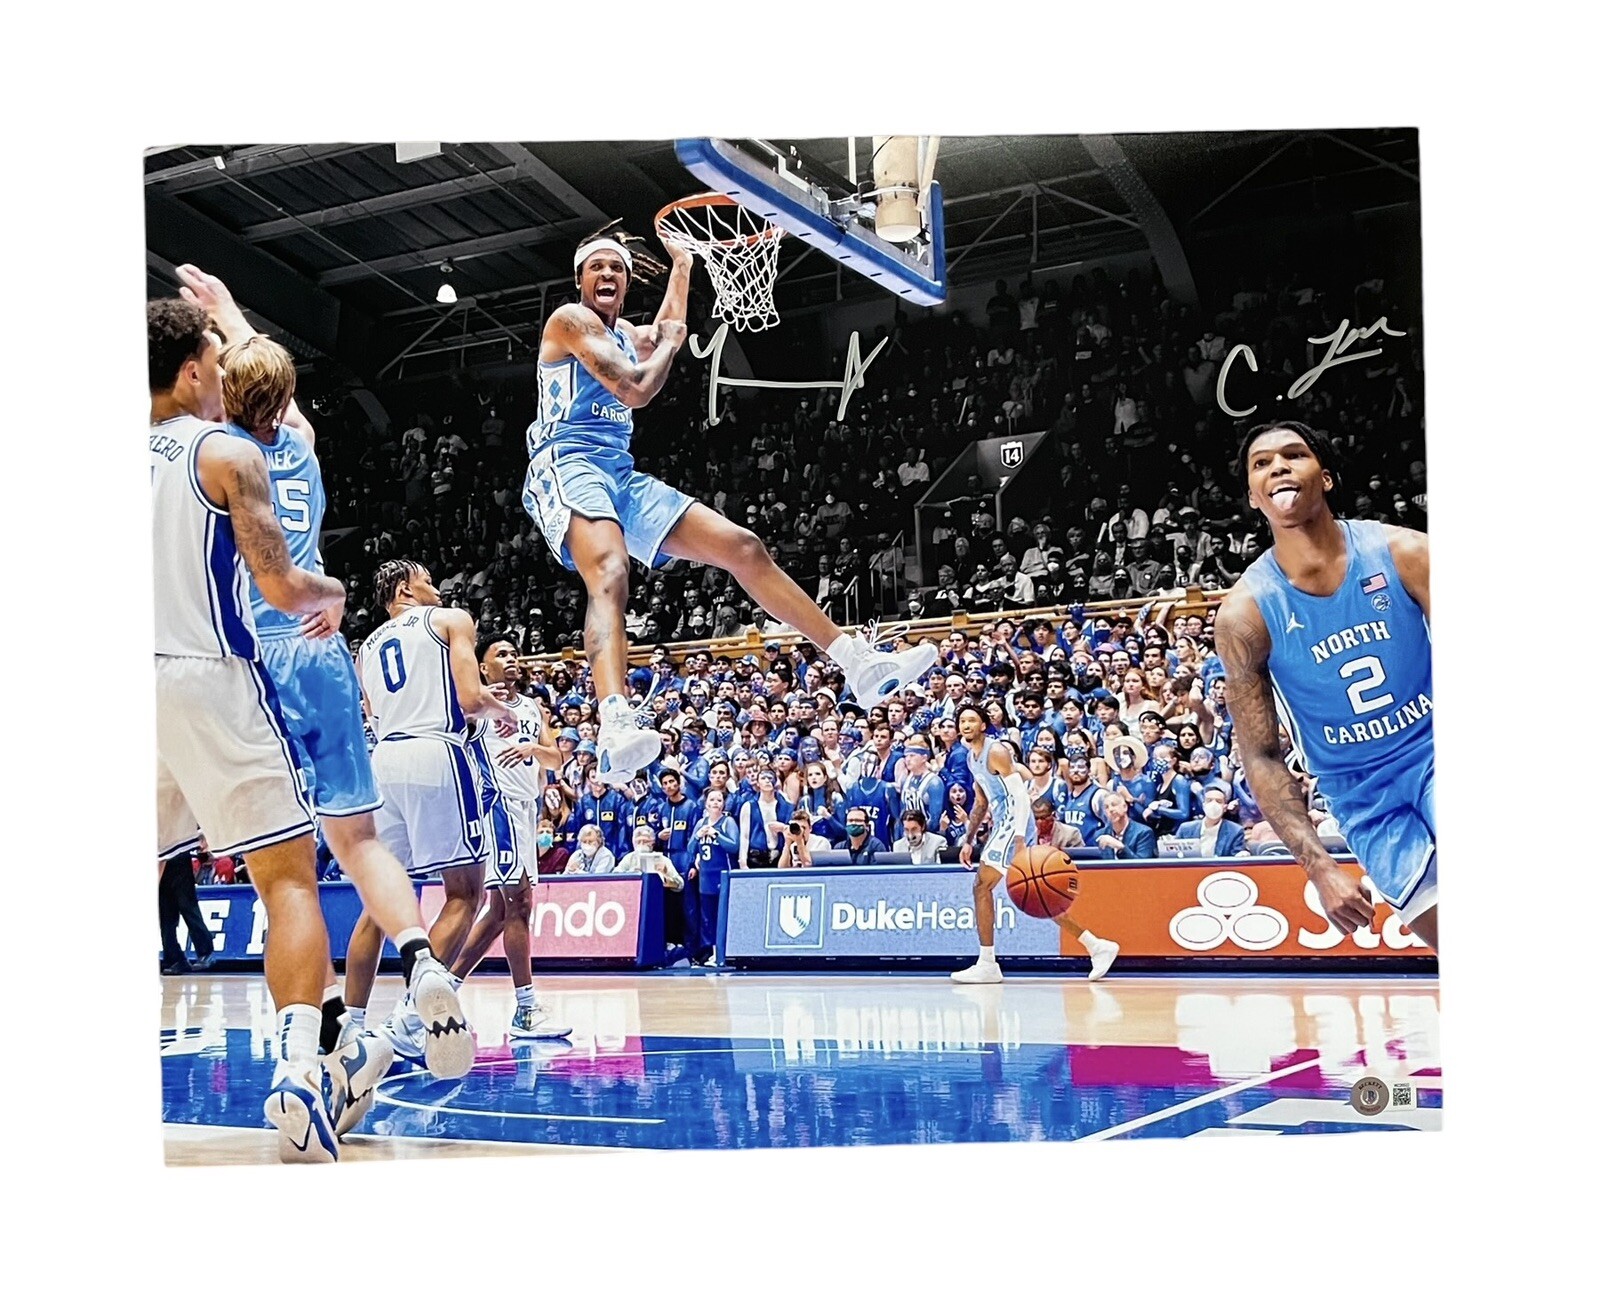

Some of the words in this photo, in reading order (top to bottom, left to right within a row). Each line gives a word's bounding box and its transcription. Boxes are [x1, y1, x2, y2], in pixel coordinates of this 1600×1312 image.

[1004, 448, 1020, 464] 14
[271, 478, 311, 533] 5
[402, 615, 420, 628] JR
[1310, 619, 1392, 664] NORTH
[378, 637, 407, 694] 0
[1338, 654, 1395, 716] 2
[1323, 693, 1434, 746] CAROLINA
[499, 850, 514, 865] D
[701, 844, 711, 861] 3
[528, 890, 626, 938] ndo
[831, 897, 1016, 931] DukeHeah
